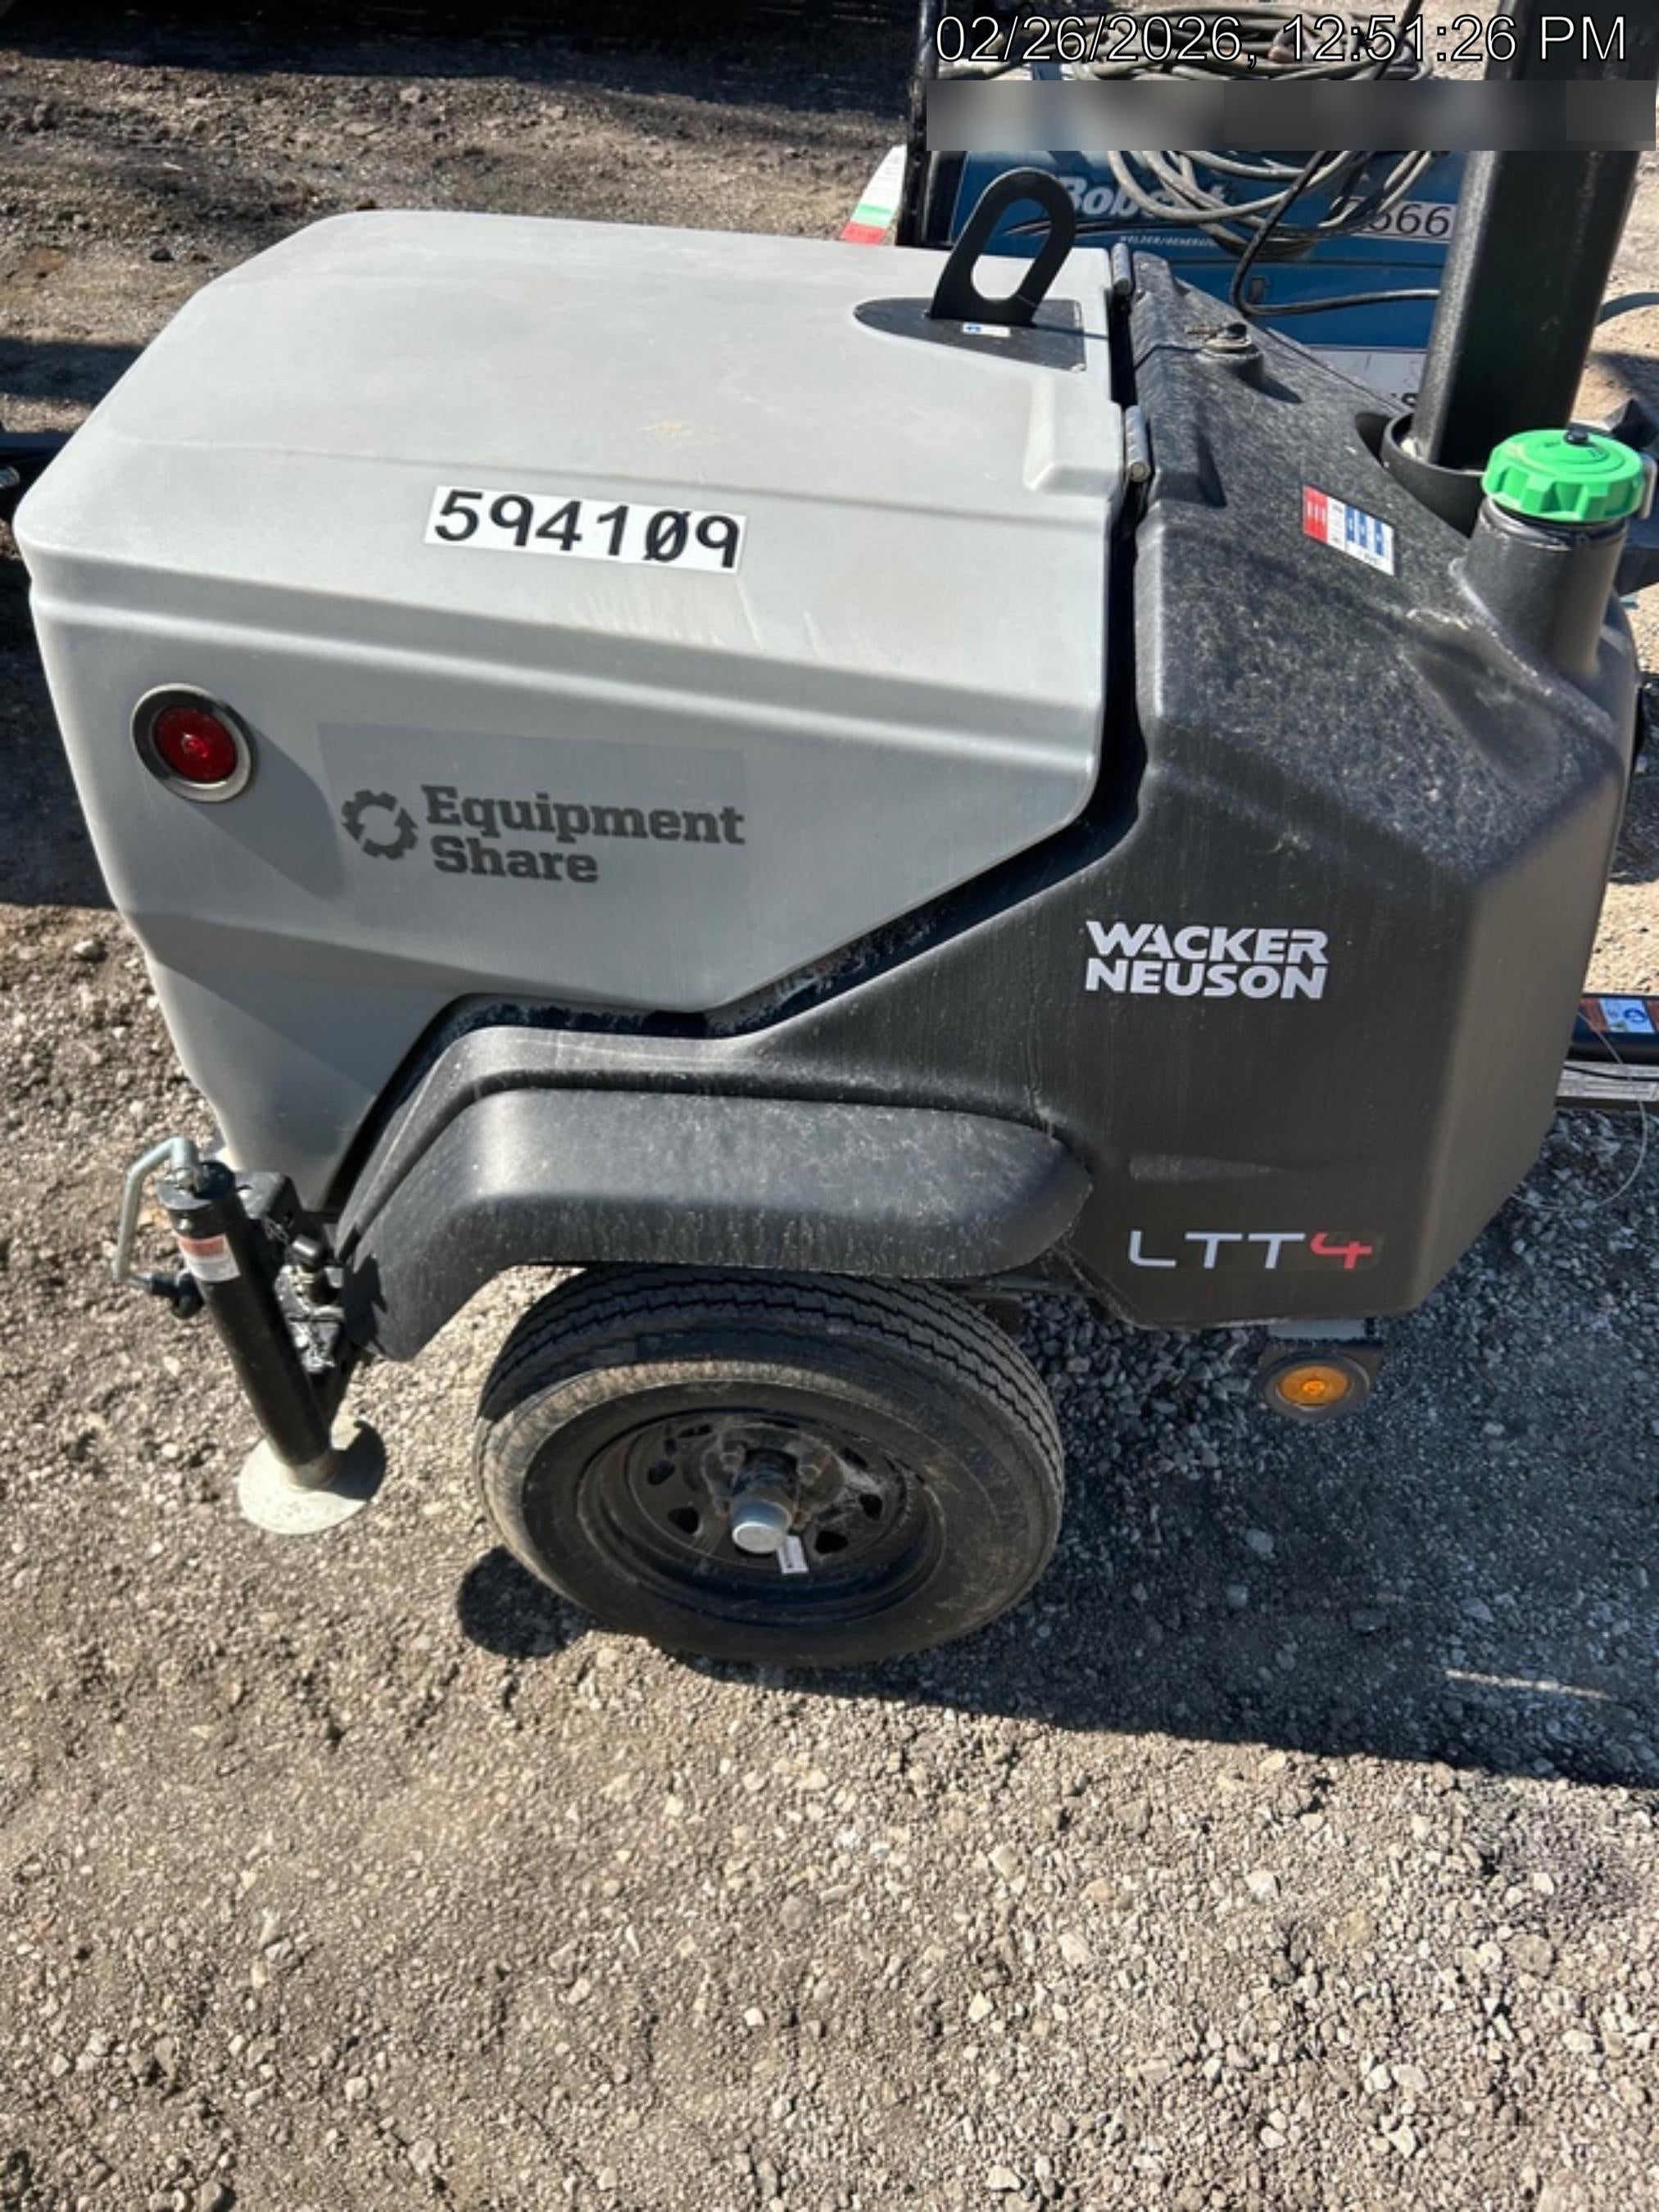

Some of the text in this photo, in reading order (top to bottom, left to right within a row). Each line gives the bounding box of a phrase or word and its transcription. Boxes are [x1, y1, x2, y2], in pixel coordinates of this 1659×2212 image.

[421, 783, 746, 845] Equipment
[430, 834, 601, 884] Share
[1085, 920, 1330, 965] WACKER
[1084, 957, 1329, 1000] NEUSON
[1127, 1229, 1373, 1270] LTT4
